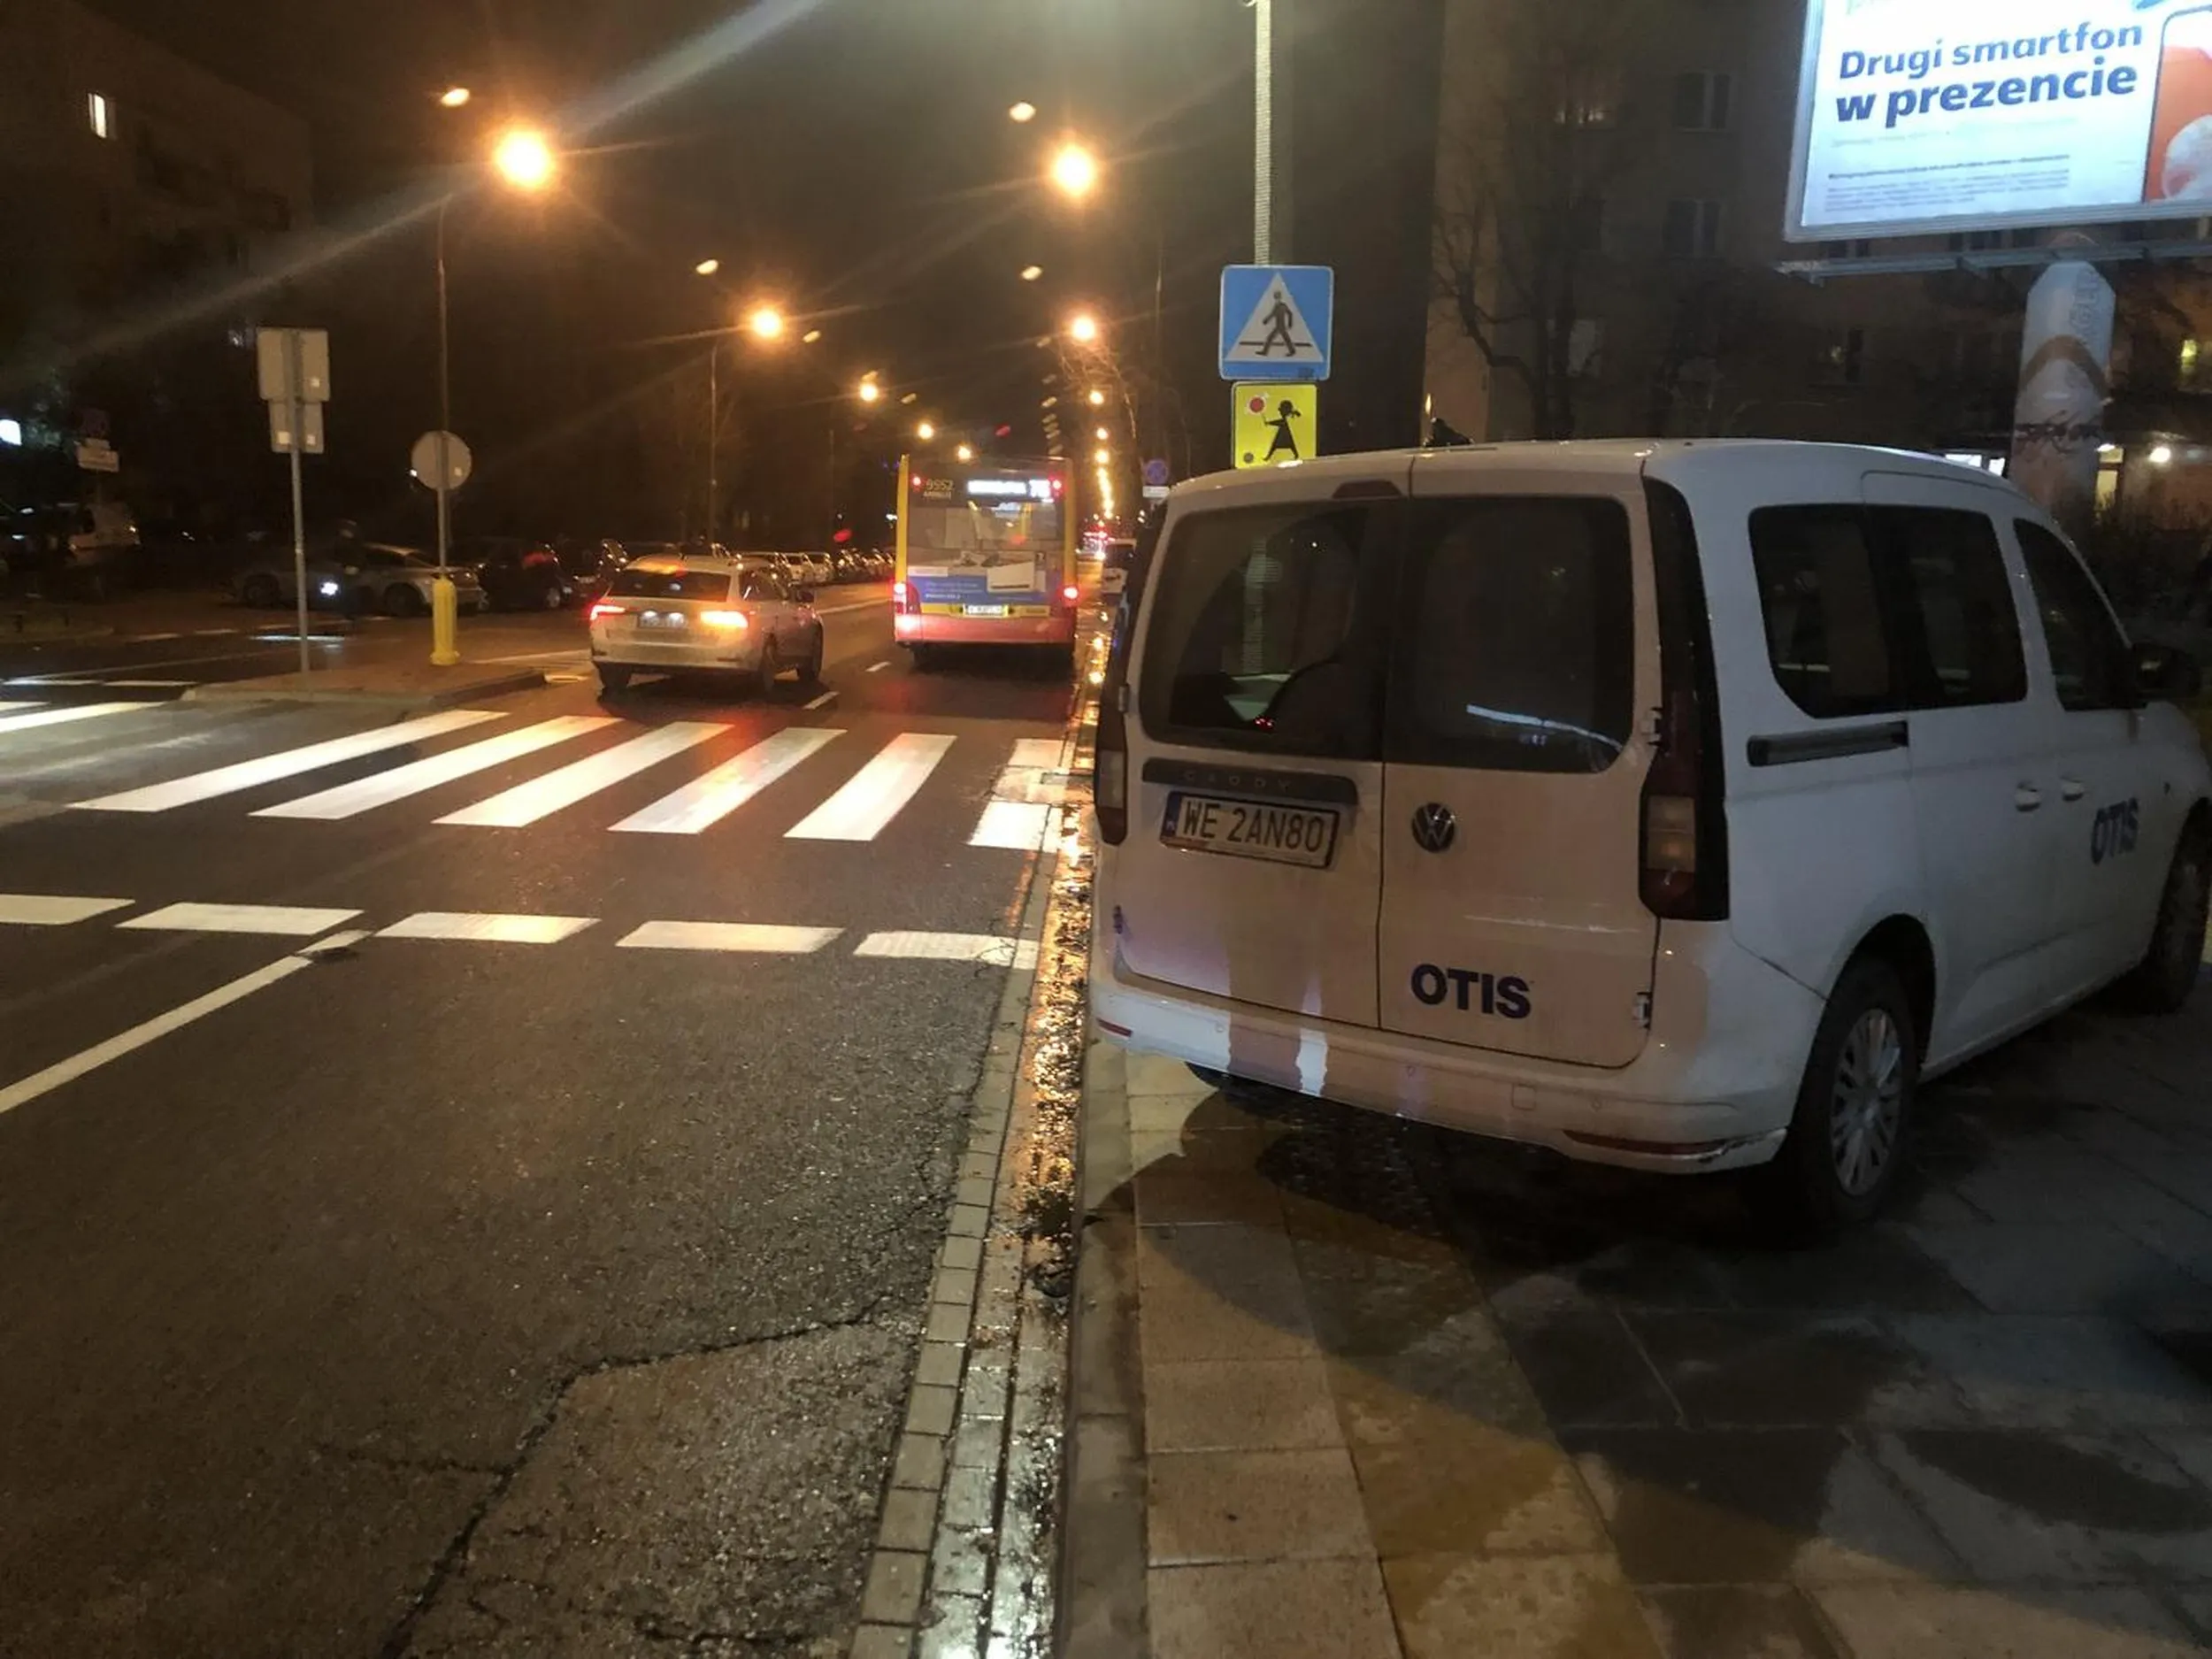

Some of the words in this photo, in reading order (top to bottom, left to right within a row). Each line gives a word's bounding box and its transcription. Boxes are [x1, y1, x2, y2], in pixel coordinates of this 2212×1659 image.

[1839, 39, 1943, 81] Drugi
[1951, 21, 2143, 66] smartfon
[1835, 92, 1877, 122] w
[1884, 56, 2138, 128] prezencie
[1183, 801, 1223, 839] WE
[1226, 808, 1325, 854] 2AN80
[2091, 797, 2139, 865] OTIS
[1410, 963, 1531, 1019] OTIS
